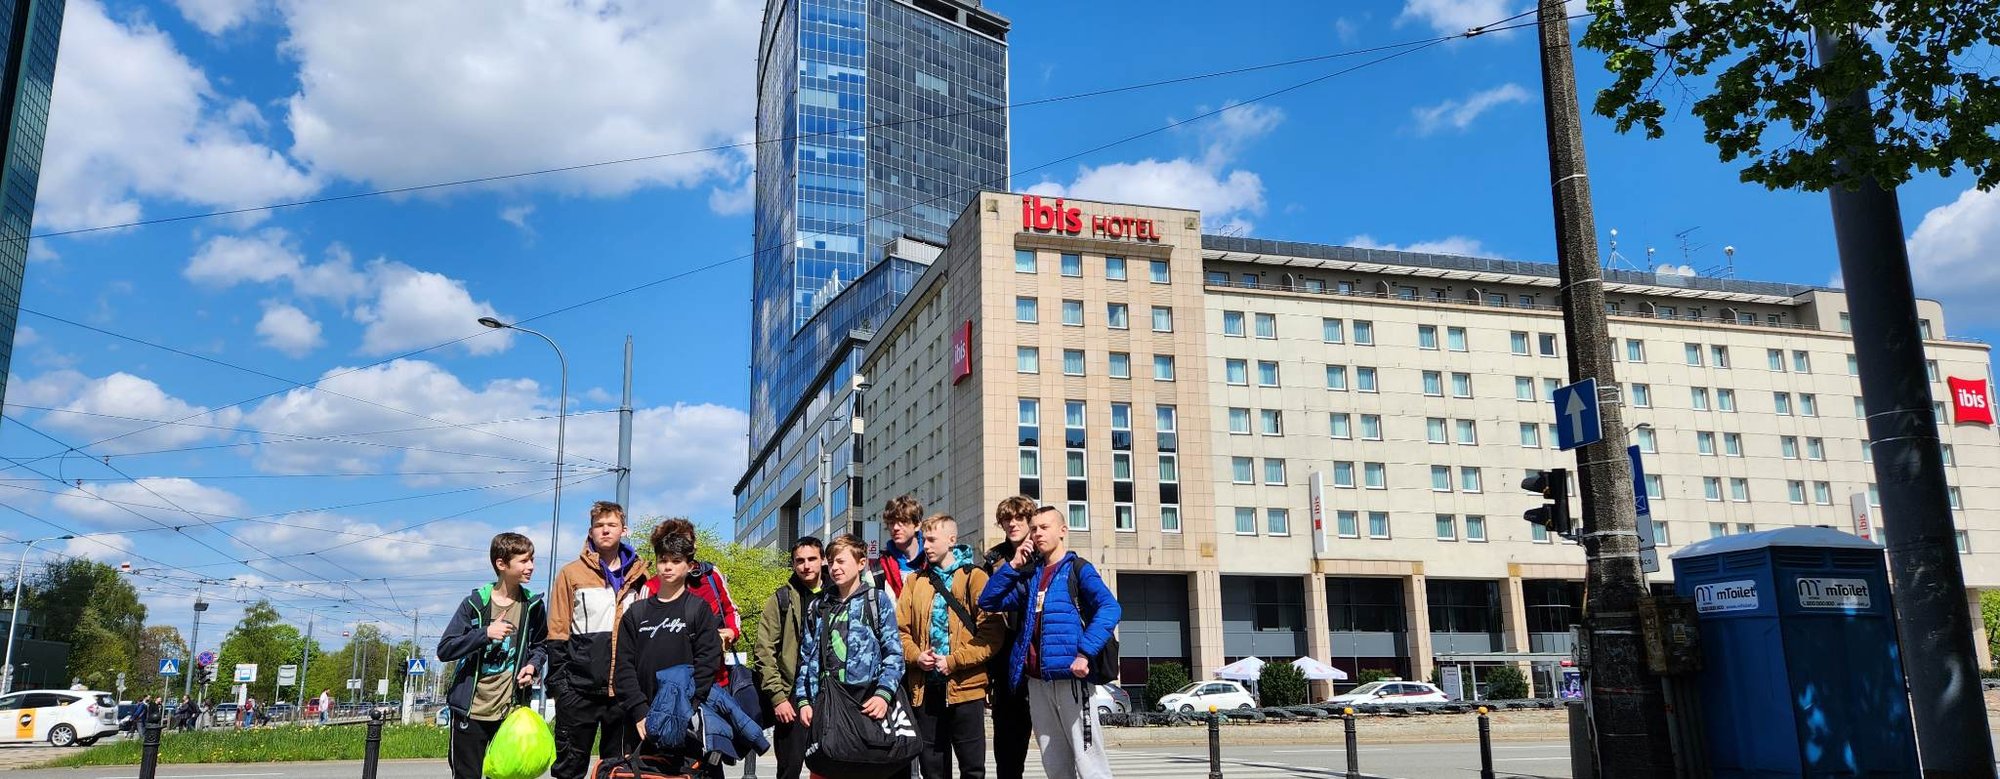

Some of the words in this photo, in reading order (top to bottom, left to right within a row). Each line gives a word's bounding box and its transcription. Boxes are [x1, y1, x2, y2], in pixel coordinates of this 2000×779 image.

[1022, 194, 1083, 233] ibis
[1092, 214, 1161, 241] HOTEL
[954, 340, 966, 365] ibis
[1958, 388, 1986, 408] ibis
[1859, 513, 1868, 531] ibis
[868, 539, 878, 555] ibis
[1716, 586, 1756, 600] mToilet
[1825, 582, 1869, 597] mToilet
